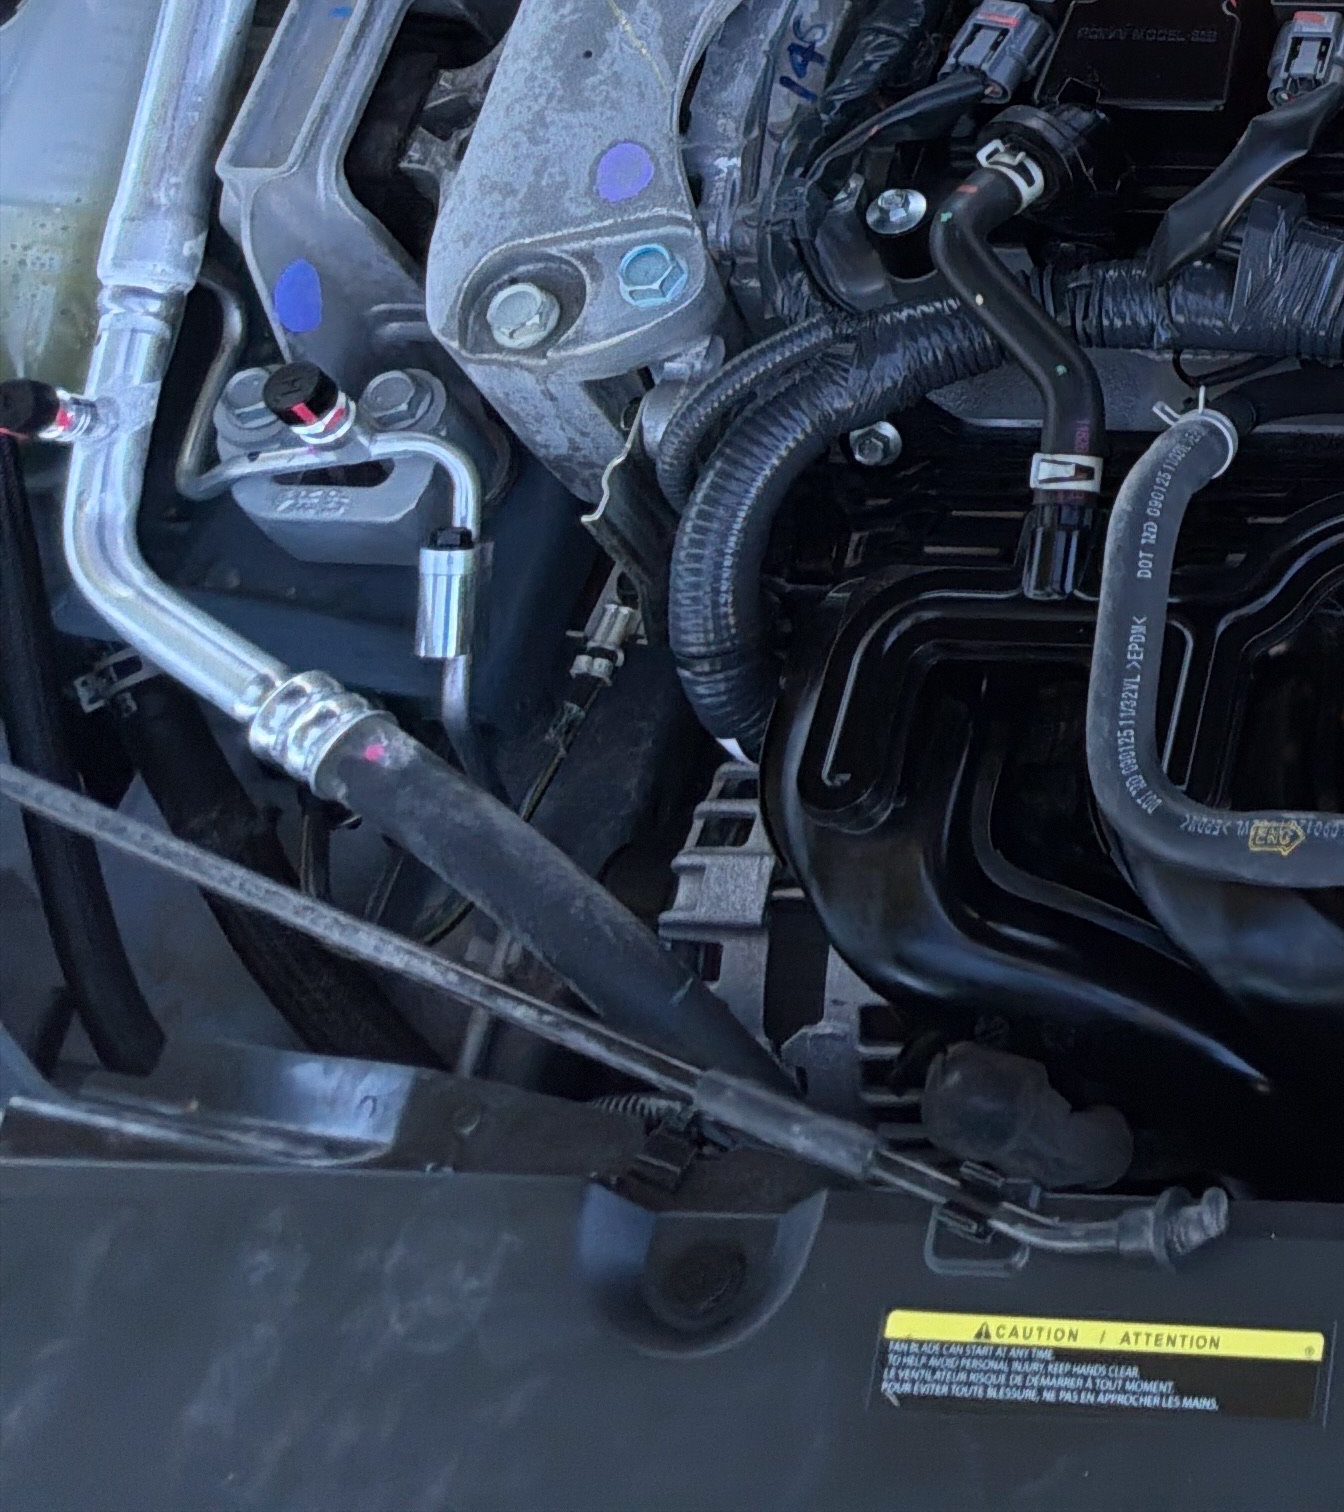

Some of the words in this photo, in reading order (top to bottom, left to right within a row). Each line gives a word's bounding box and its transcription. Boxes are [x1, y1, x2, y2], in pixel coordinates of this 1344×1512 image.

[1136, 549, 1154, 579] DOT
[889, 1340, 908, 1353] FAN
[909, 1341, 940, 1355] BLADE
[942, 1343, 963, 1356] CAN
[965, 1344, 994, 1357] START
[995, 1346, 1008, 1358] AT
[1009, 1346, 1030, 1359] ANY
[995, 1326, 1079, 1343] CAUTION
[1119, 1330, 1222, 1351] ATTENTION
[887, 1353, 901, 1366] TO
[902, 1354, 927, 1368] HELP
[928, 1355, 959, 1369] AVOID
[960, 1358, 1010, 1373] PERSONAL
[1047, 1361, 1072, 1375] KEEP
[1072, 1363, 1107, 1376] HANDS
[883, 1368, 896, 1380] LE
[898, 1368, 968, 1384] VENTILATEUR
[969, 1370, 1006, 1385] RISQUE
[1009, 1373, 1024, 1386] DE
[1095, 1378, 1123, 1391] TOUT
[881, 1381, 911, 1394] POUR
[951, 1384, 985, 1398] TOUTE
[1042, 1389, 1057, 1402] NE
[1059, 1391, 1078, 1404] PAS
[1080, 1391, 1095, 1404] EN
[1097, 1392, 1160, 1407] APPROCHER
[1162, 1395, 1180, 1408] LES
